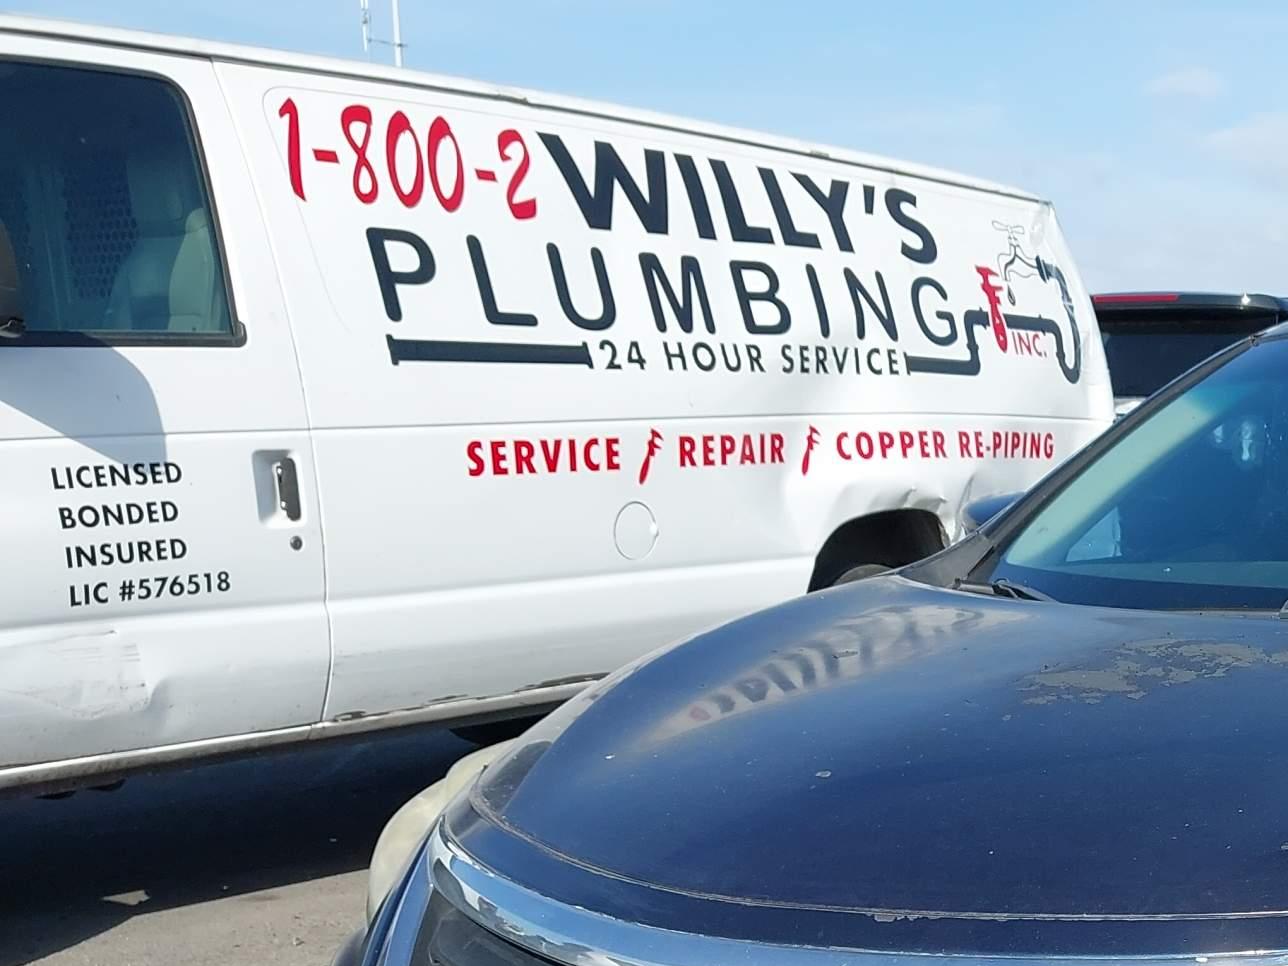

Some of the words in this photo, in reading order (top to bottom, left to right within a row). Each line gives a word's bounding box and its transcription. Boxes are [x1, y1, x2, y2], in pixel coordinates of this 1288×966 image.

[537, 132, 938, 265] WILLY'S
[365, 227, 959, 347] PLUMBING
[599, 339, 646, 370] 24
[664, 341, 765, 372] HOUR
[781, 344, 899, 375] SERVICE
[1012, 330, 1048, 359] INC.
[466, 437, 620, 477] SERVICE
[679, 433, 785, 467] REPAIR
[836, 431, 946, 460] COPPER
[958, 432, 1054, 460] RE-PIPING
[51, 461, 182, 490] LICENSED
[58, 501, 179, 529] BONDED
[65, 538, 187, 569] INSURED
[69, 582, 109, 607] LIC
[119, 571, 231, 602] #576518
